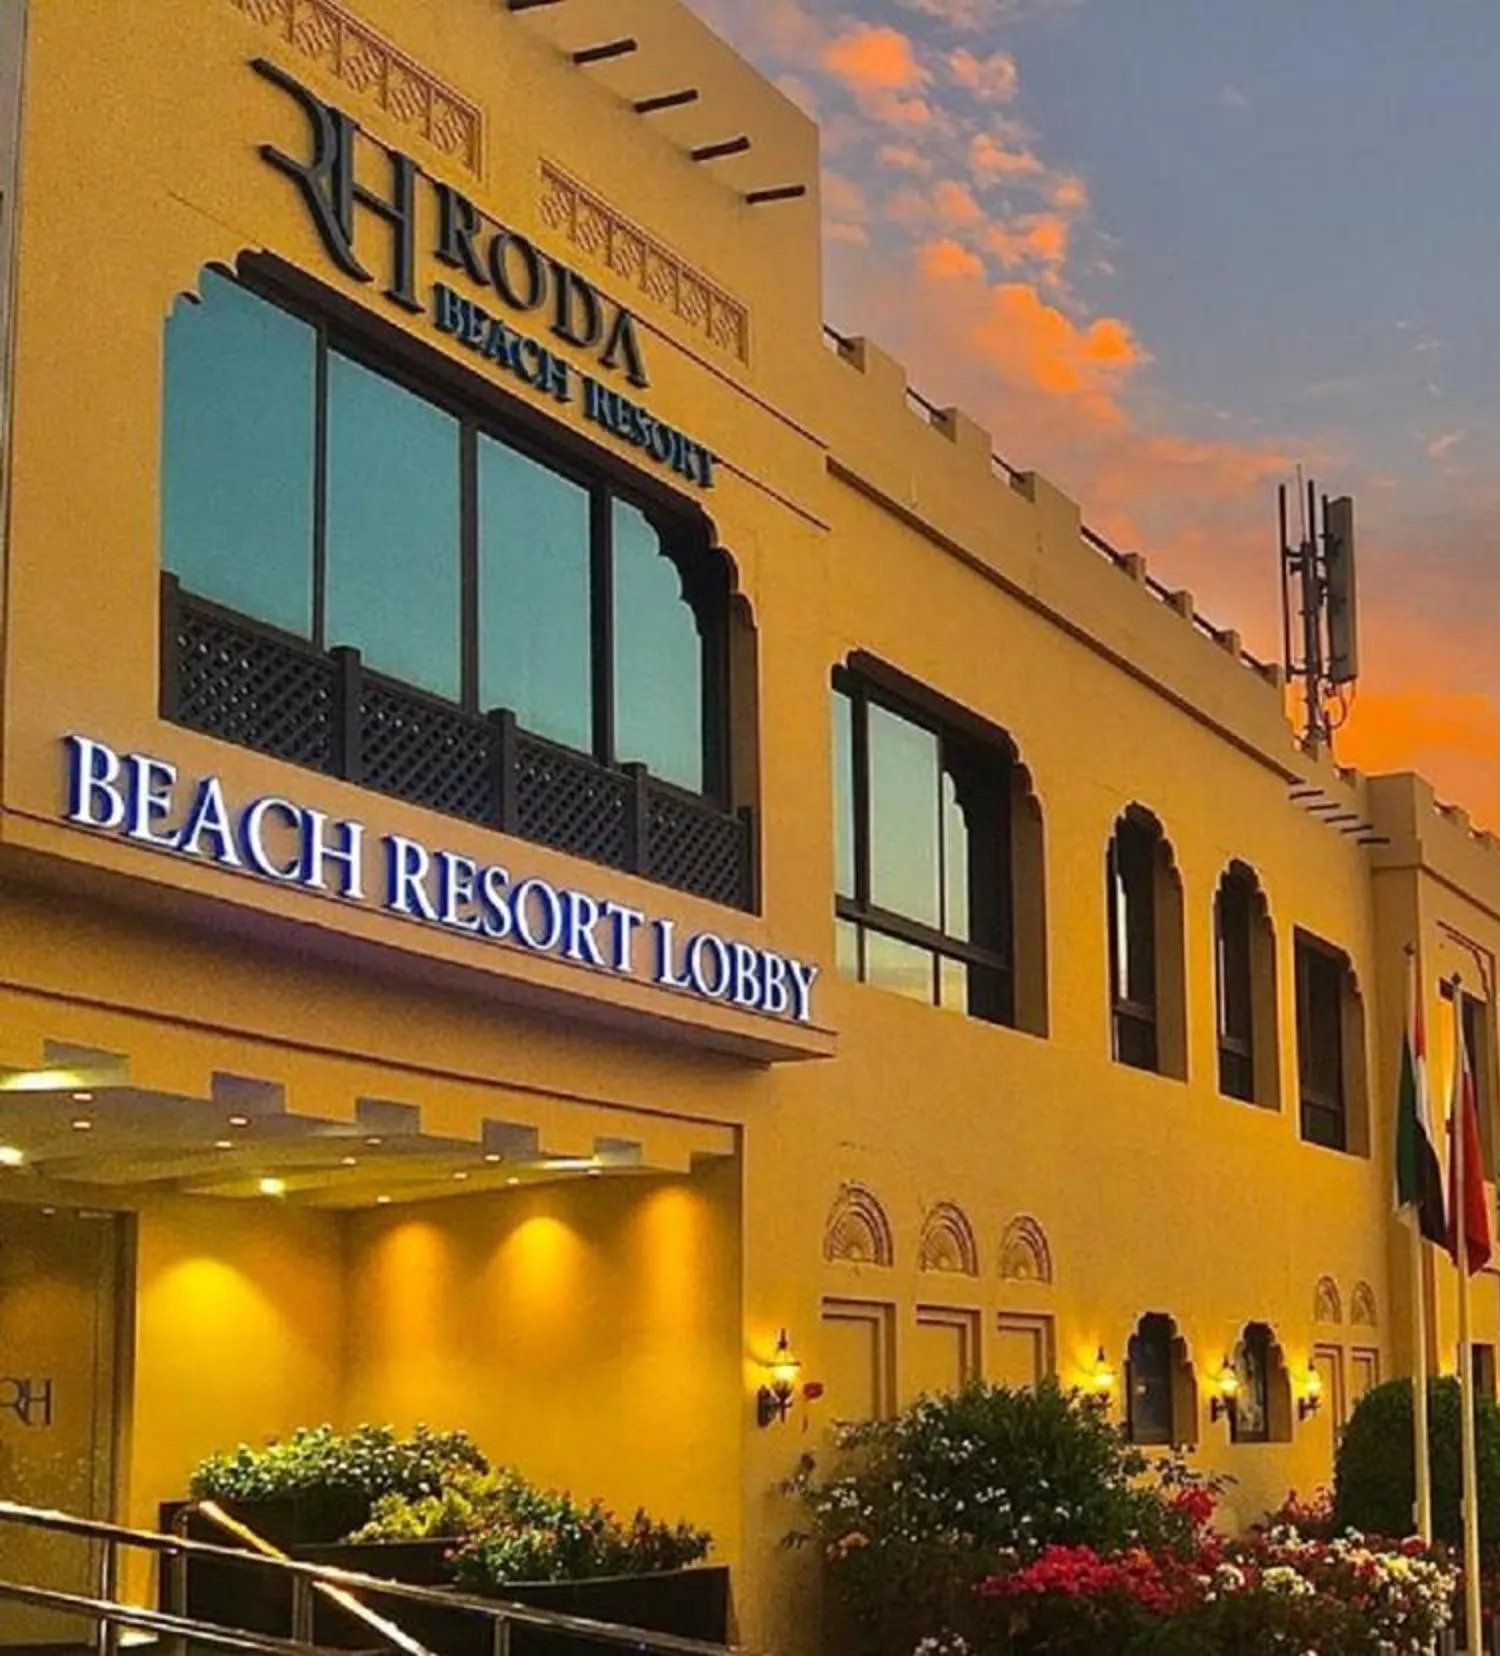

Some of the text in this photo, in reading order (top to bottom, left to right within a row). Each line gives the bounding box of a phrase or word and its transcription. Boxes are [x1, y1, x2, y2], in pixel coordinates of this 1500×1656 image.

[433, 281, 721, 488] BEACH RESORT
[434, 181, 651, 389] RODA
[64, 734, 819, 1023] BEACH RESORT LOBBY
